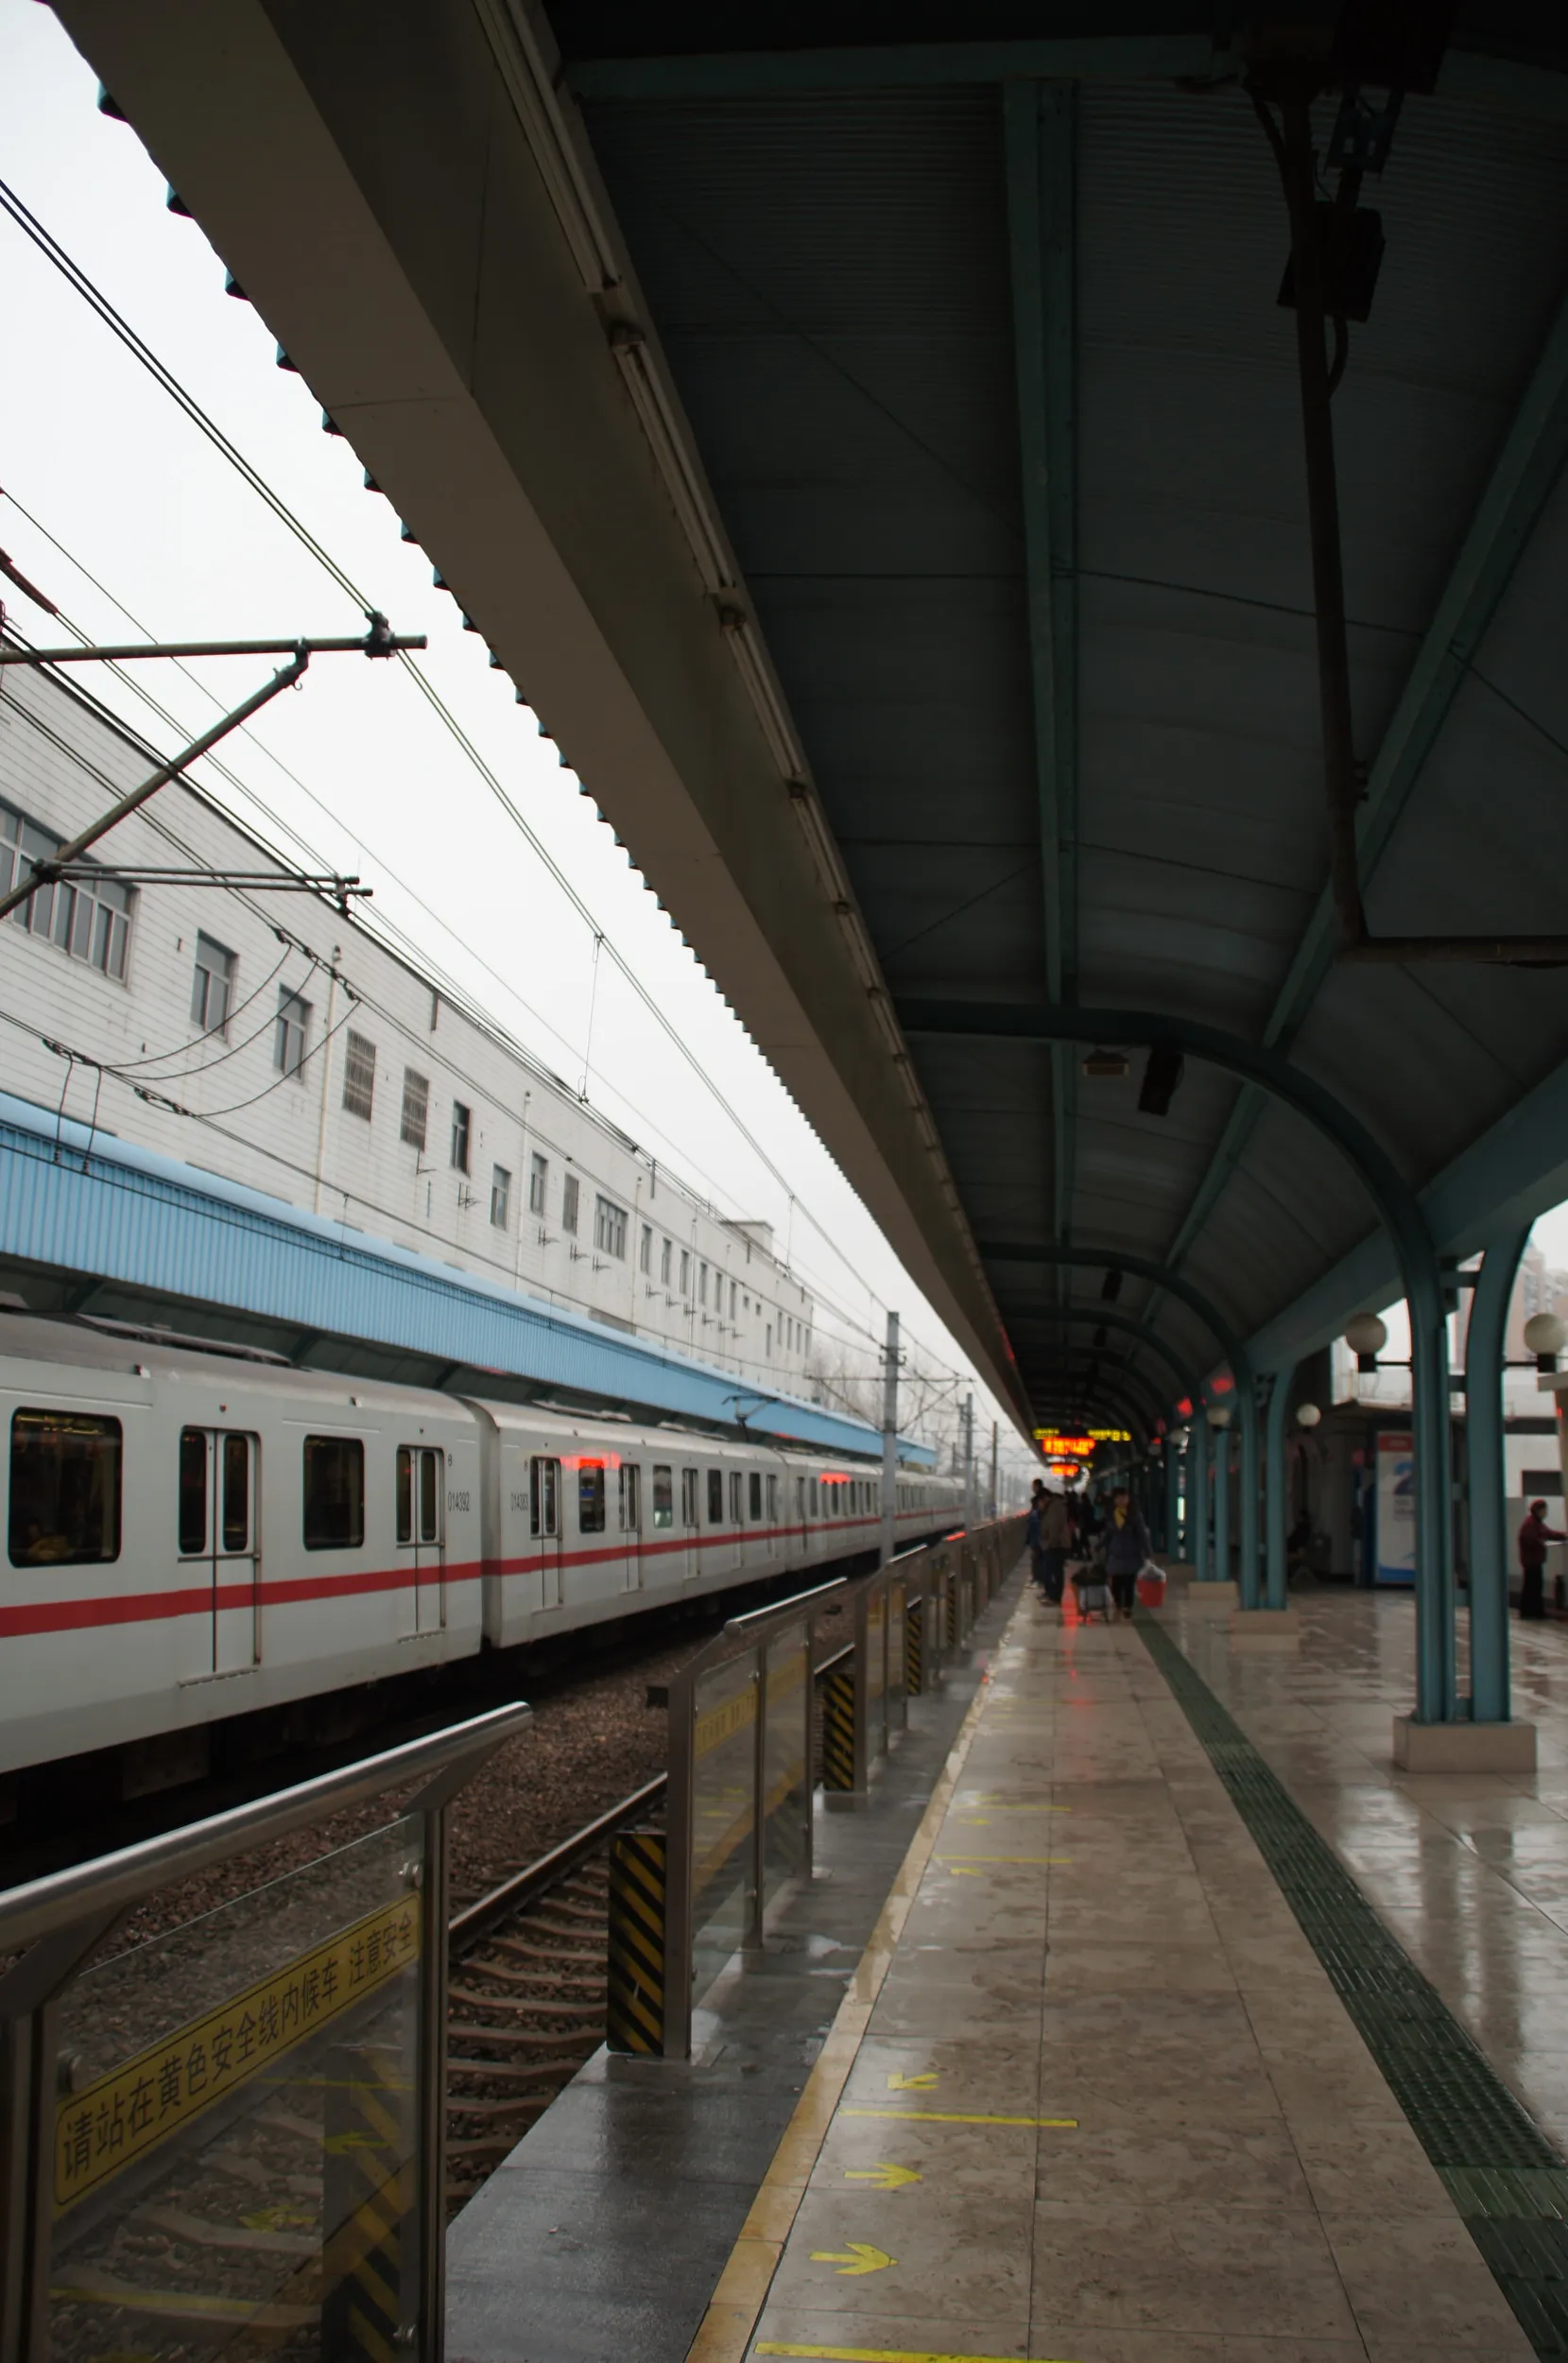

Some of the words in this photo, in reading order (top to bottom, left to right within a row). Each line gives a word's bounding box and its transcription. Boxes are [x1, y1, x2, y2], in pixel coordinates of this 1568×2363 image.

[62, 1958, 338, 2182] 请站在黄色安全线内候车
[349, 1909, 412, 1988] 注意安全
